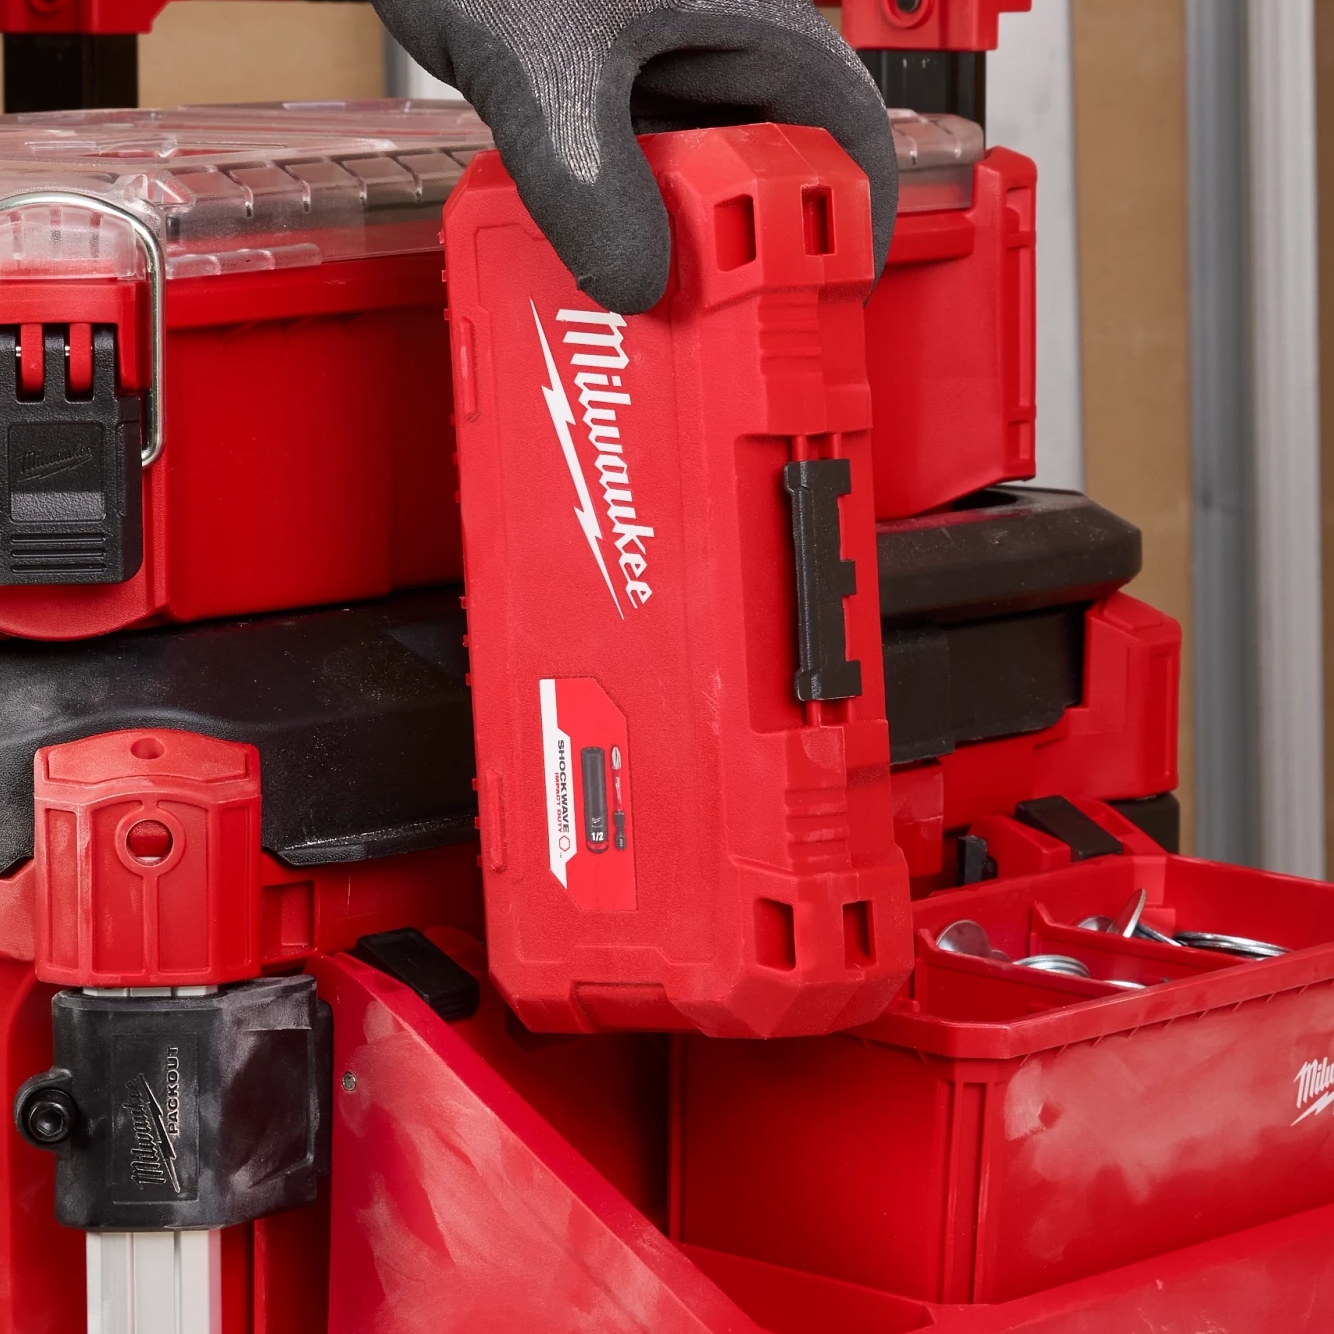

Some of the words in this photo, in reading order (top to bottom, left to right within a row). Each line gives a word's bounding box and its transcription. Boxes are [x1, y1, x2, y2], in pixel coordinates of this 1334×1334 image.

[556, 308, 654, 609] Milwaukee
[554, 772, 562, 807] IMPACT
[557, 739, 570, 834] SHOCKWAVE
[591, 831, 604, 842] 1/2
[121, 1077, 167, 1190] Milwaukee
[167, 1045, 181, 1137] PACKOUT
